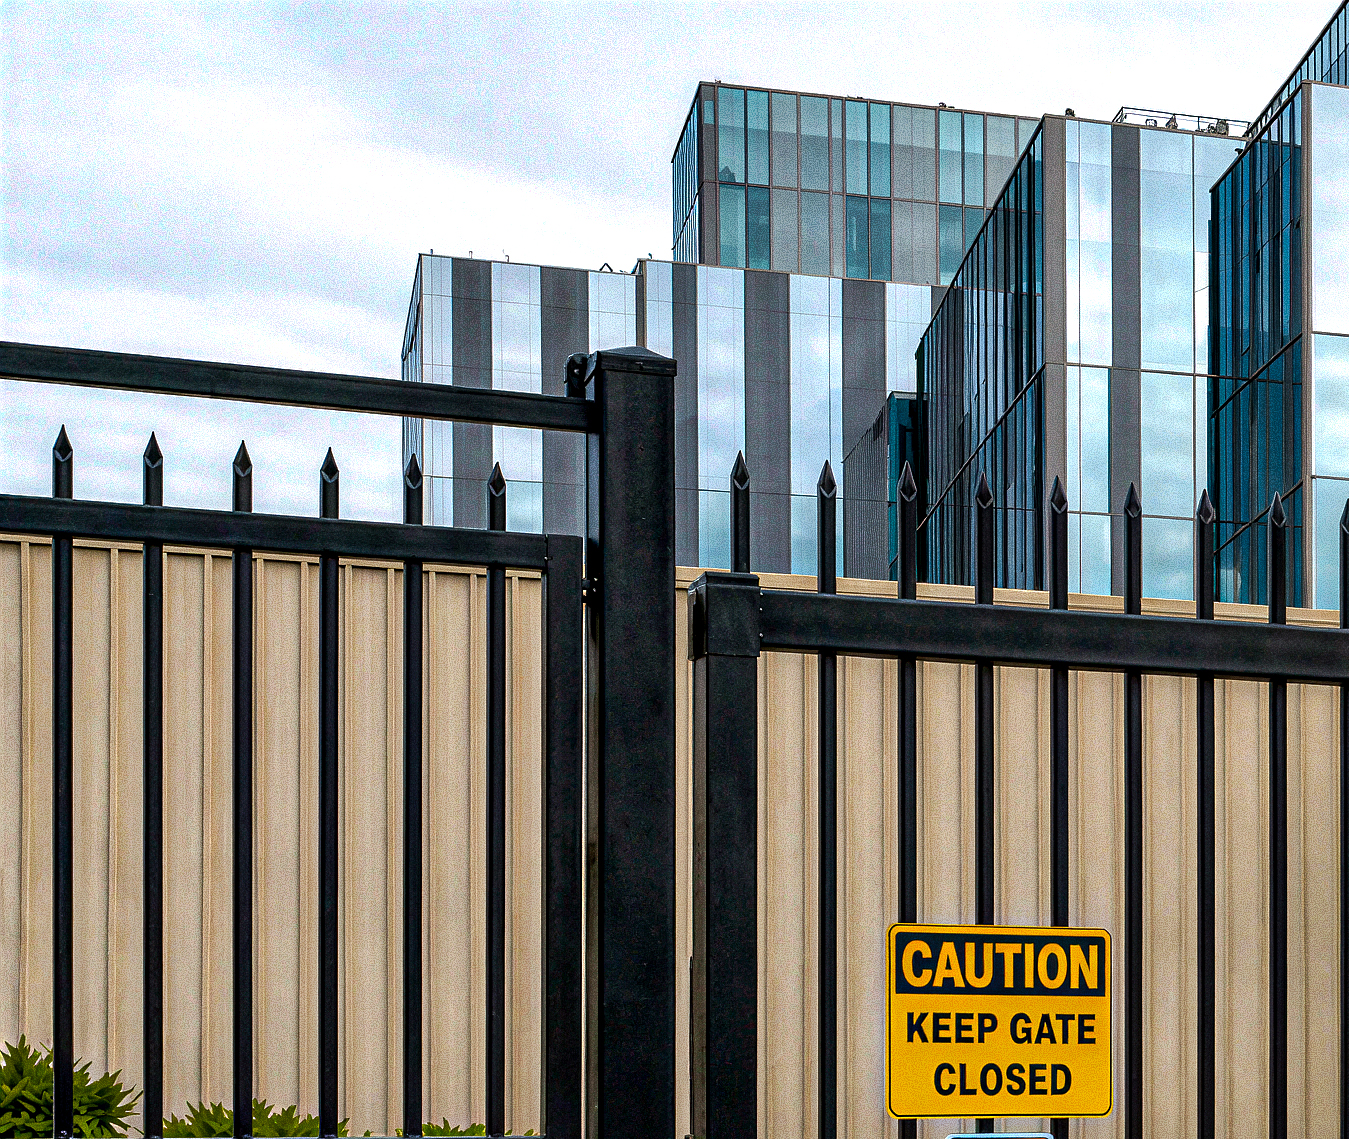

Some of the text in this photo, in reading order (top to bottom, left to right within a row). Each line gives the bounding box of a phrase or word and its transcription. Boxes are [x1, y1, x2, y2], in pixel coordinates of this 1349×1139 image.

[901, 940, 1098, 990] CAUTION
[906, 1012, 1096, 1044] KEEP GATE
[934, 1062, 1072, 1096] CLOSED
